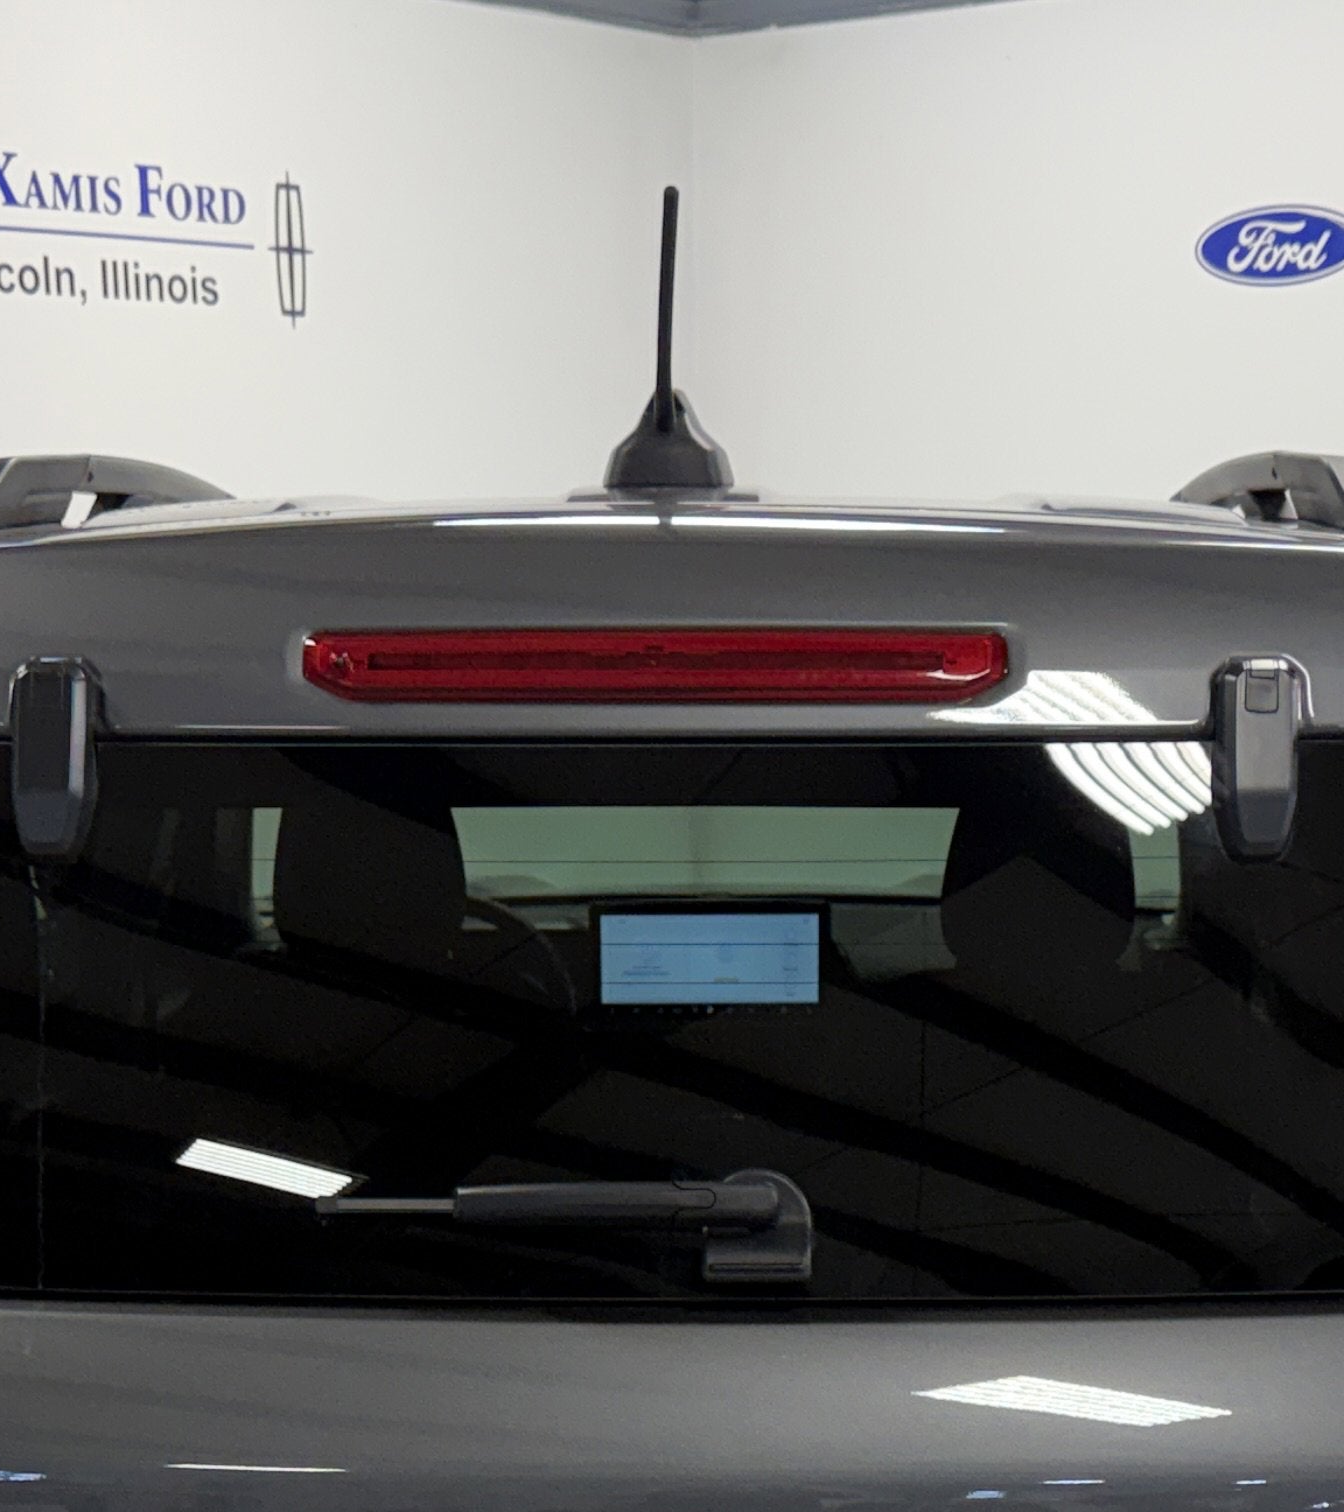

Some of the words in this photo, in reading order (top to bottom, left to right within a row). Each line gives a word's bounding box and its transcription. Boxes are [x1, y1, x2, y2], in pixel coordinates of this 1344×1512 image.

[135, 164, 246, 226] FORD
[1226, 219, 1328, 272] Ford
[100, 259, 219, 306] Illinois
